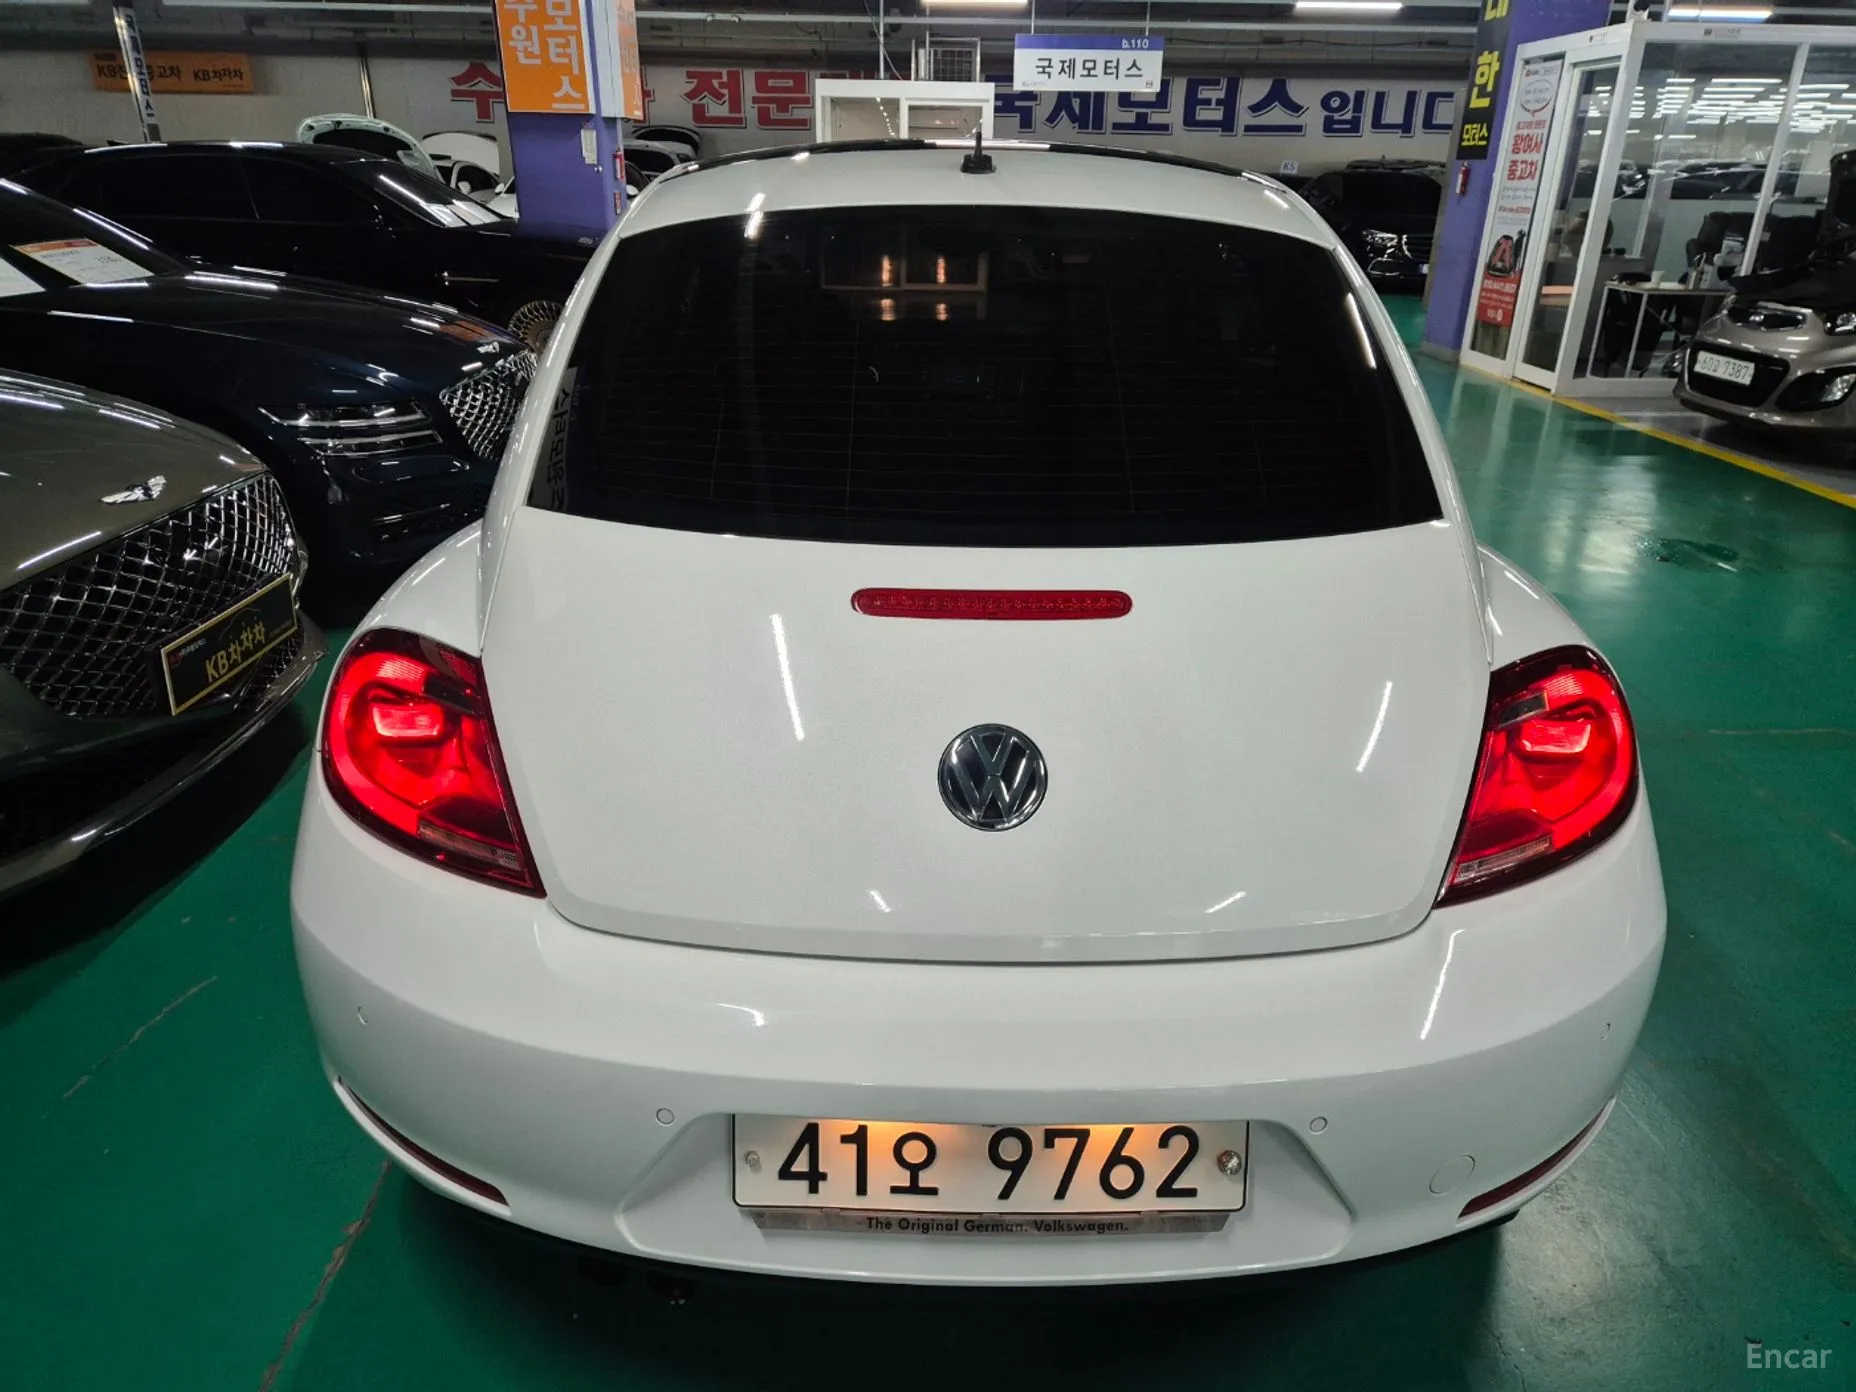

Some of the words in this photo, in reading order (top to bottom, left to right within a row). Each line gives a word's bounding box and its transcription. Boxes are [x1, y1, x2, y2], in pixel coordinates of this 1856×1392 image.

[544, 0, 585, 109] 모터스
[1035, 57, 1144, 79] 국제모터스
[1461, 123, 1488, 146] 모터스
[778, 1122, 939, 1197] 41오
[987, 1125, 1201, 1200] 9762
[866, 1217, 893, 1231] The
[899, 1217, 958, 1234] Original
[964, 1218, 1029, 1234] German.
[1034, 1218, 1129, 1235] Volkswagen.
